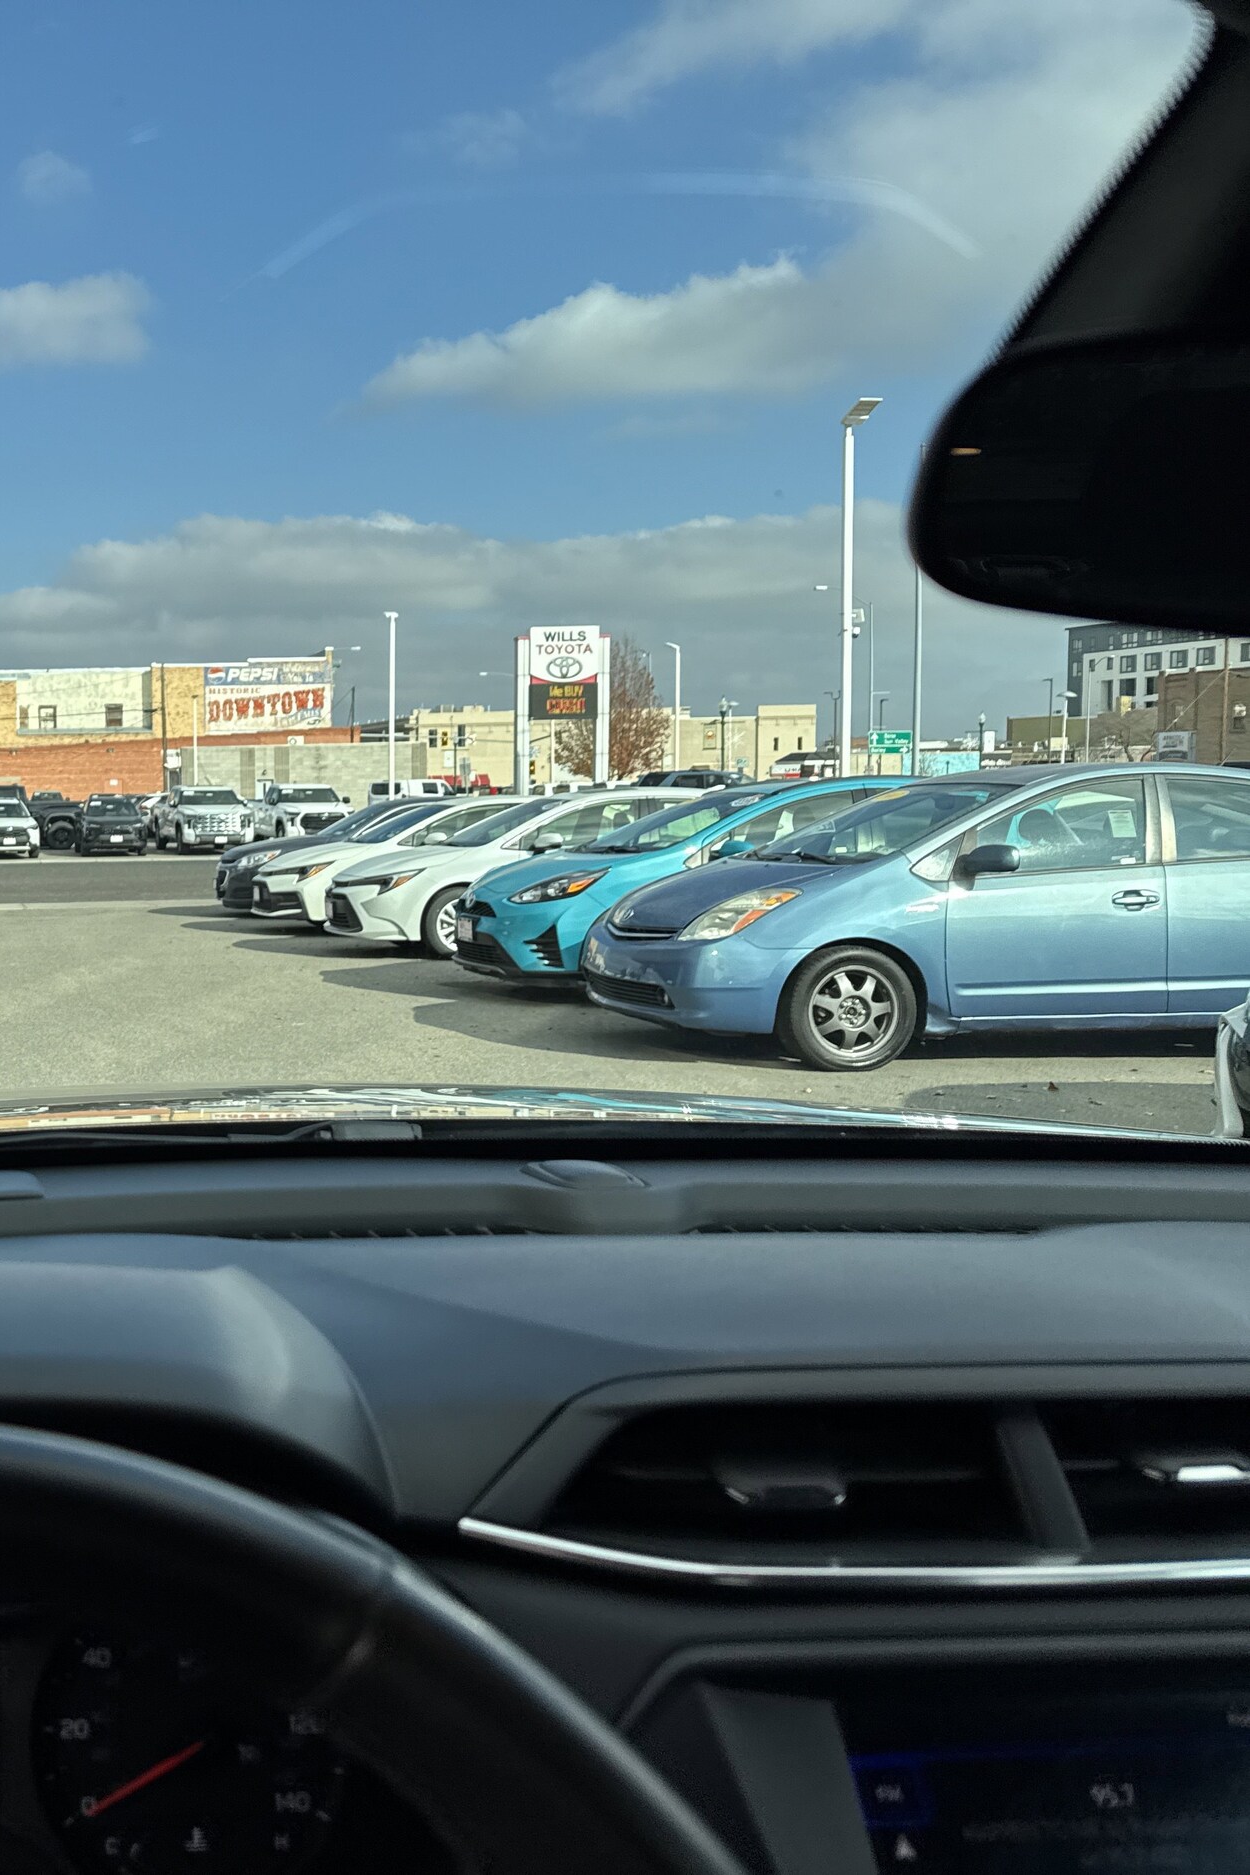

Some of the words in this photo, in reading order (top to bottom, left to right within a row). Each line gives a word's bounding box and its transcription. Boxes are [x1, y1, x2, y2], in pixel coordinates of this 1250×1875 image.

[543, 630, 587, 642] WILLS
[536, 643, 593, 655] TOYOTA
[227, 667, 279, 682] PEPSI
[208, 687, 261, 695] HISTORIC
[564, 685, 584, 697] BUY
[207, 687, 326, 724] DOWNTOWN
[82, 1646, 112, 1669] 40
[59, 1717, 91, 1741] 20
[274, 1789, 312, 1813] 140
